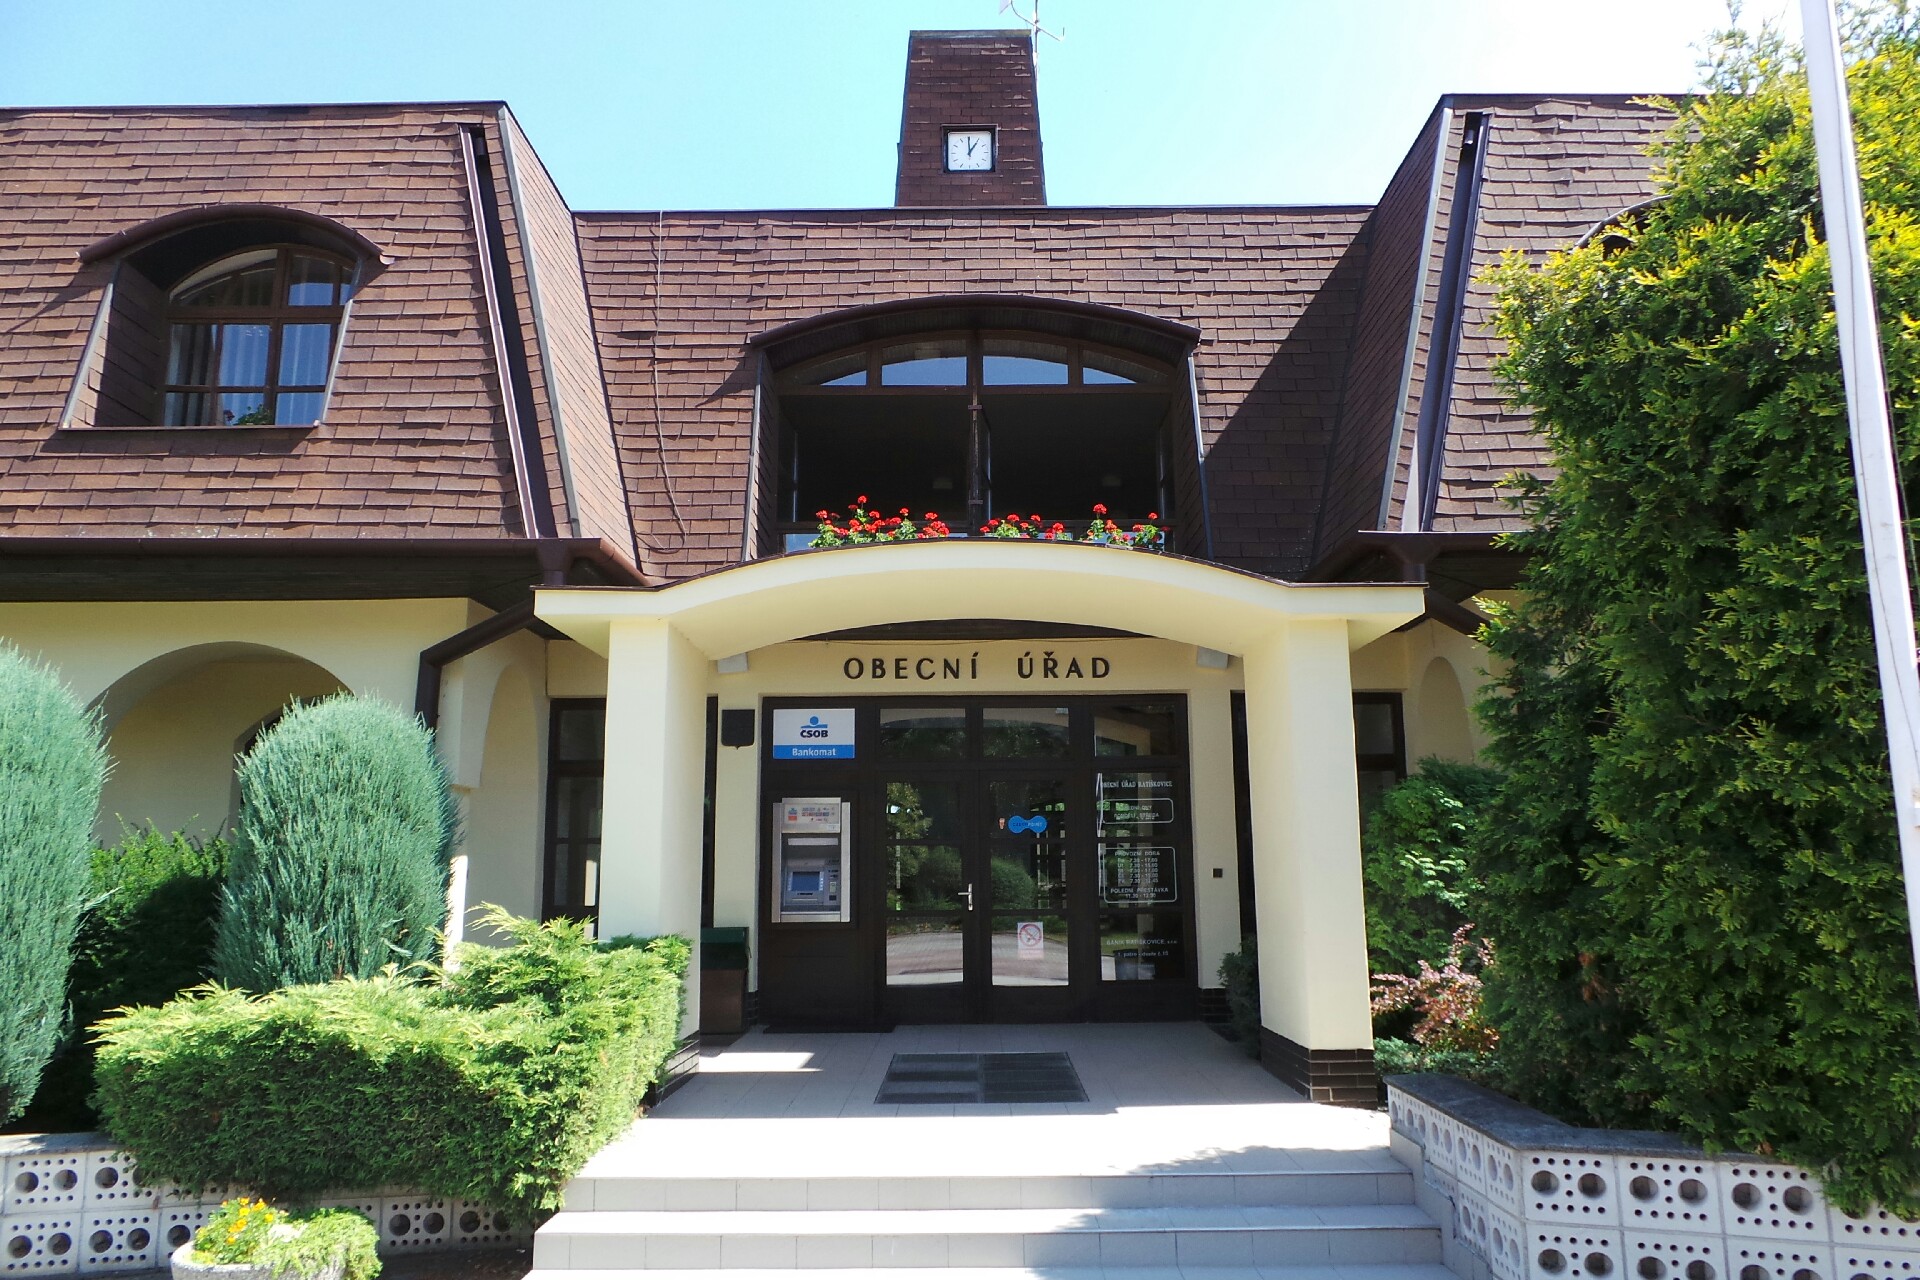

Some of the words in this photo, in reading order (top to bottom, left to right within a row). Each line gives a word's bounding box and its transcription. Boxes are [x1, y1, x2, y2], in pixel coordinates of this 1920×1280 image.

[843, 651, 979, 680] OBECNÍ
[1017, 651, 1110, 679] ÚŘAD
[792, 748, 836, 756] Bankomat
